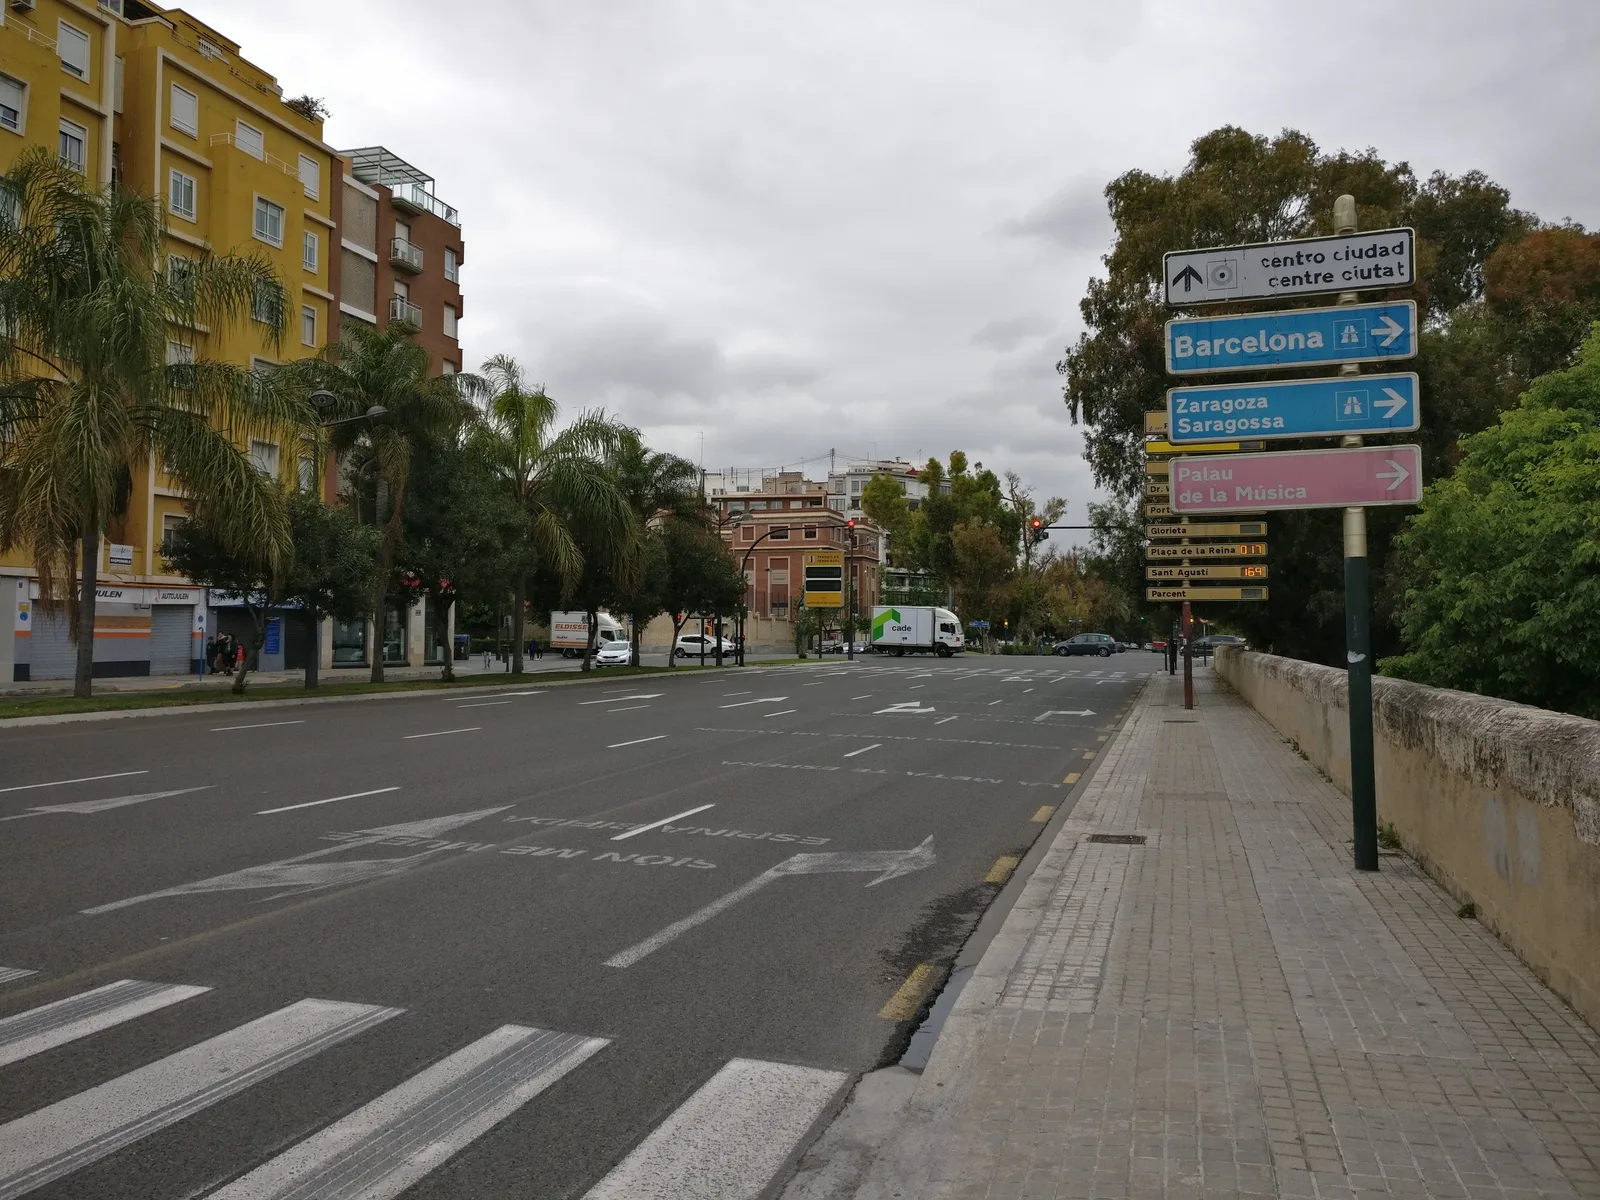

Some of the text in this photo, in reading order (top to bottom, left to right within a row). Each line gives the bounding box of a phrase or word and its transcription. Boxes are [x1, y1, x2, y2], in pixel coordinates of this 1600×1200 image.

[1261, 240, 1405, 269] centro ciudad
[1268, 261, 1405, 288] centre ciutat
[1174, 329, 1324, 358] Barcelona
[1176, 396, 1268, 414] Zaragoza
[1177, 416, 1285, 434] Saragossa
[1178, 466, 1233, 482] Palau
[1179, 489, 1203, 504] de
[1209, 487, 1228, 503] la
[1235, 484, 1308, 502] Música
[1150, 527, 1187, 535] Glorieta
[1151, 548, 1178, 556] Plaça
[1196, 547, 1207, 555] la
[1208, 546, 1236, 554] Reina
[1177, 568, 1208, 578] Agustí
[1244, 567, 1262, 577] 169
[161, 592, 189, 600] AUTOJULEN
[1151, 590, 1187, 598] Parcent
[891, 624, 912, 632] cade
[660, 824, 832, 846] ESPINA
